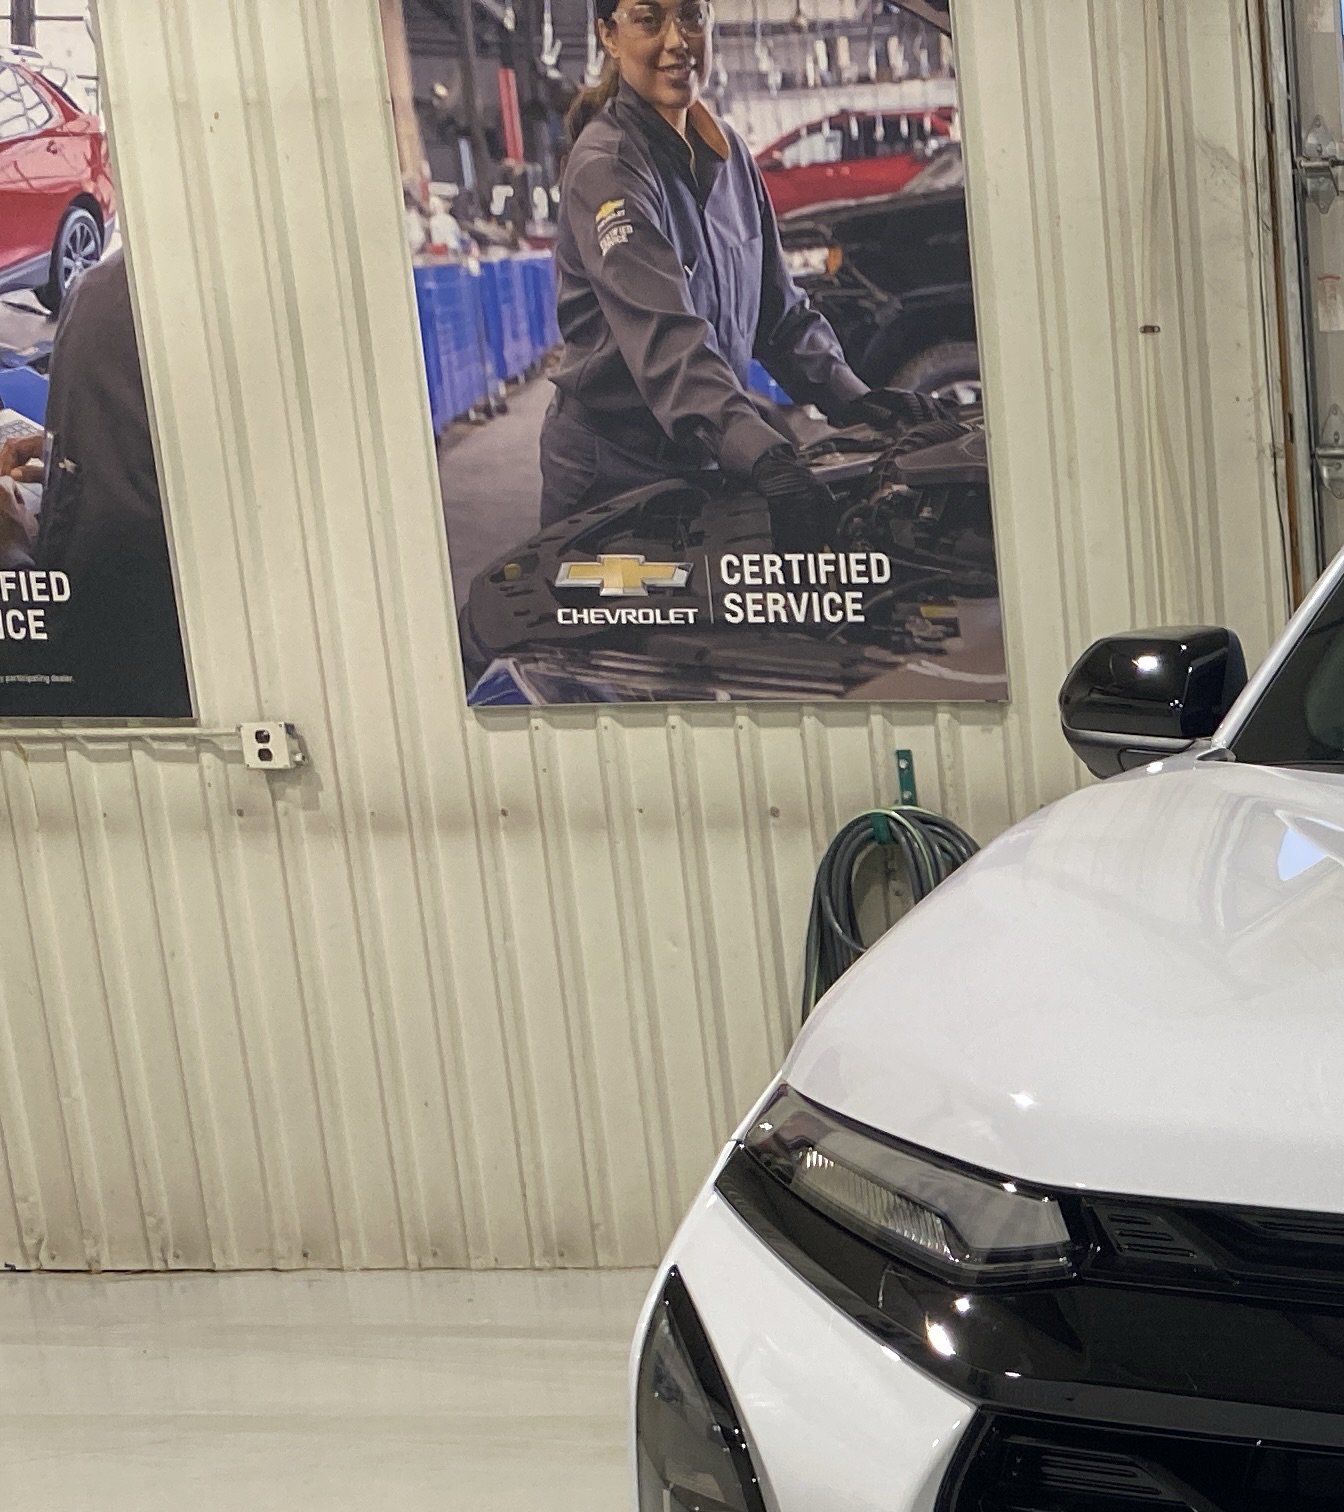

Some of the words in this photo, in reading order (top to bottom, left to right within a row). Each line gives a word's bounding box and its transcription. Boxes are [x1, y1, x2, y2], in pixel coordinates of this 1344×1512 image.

[720, 552, 891, 586] CERTIFIED
[556, 607, 698, 625] CHEVROLET
[723, 591, 865, 623] SERVICE
